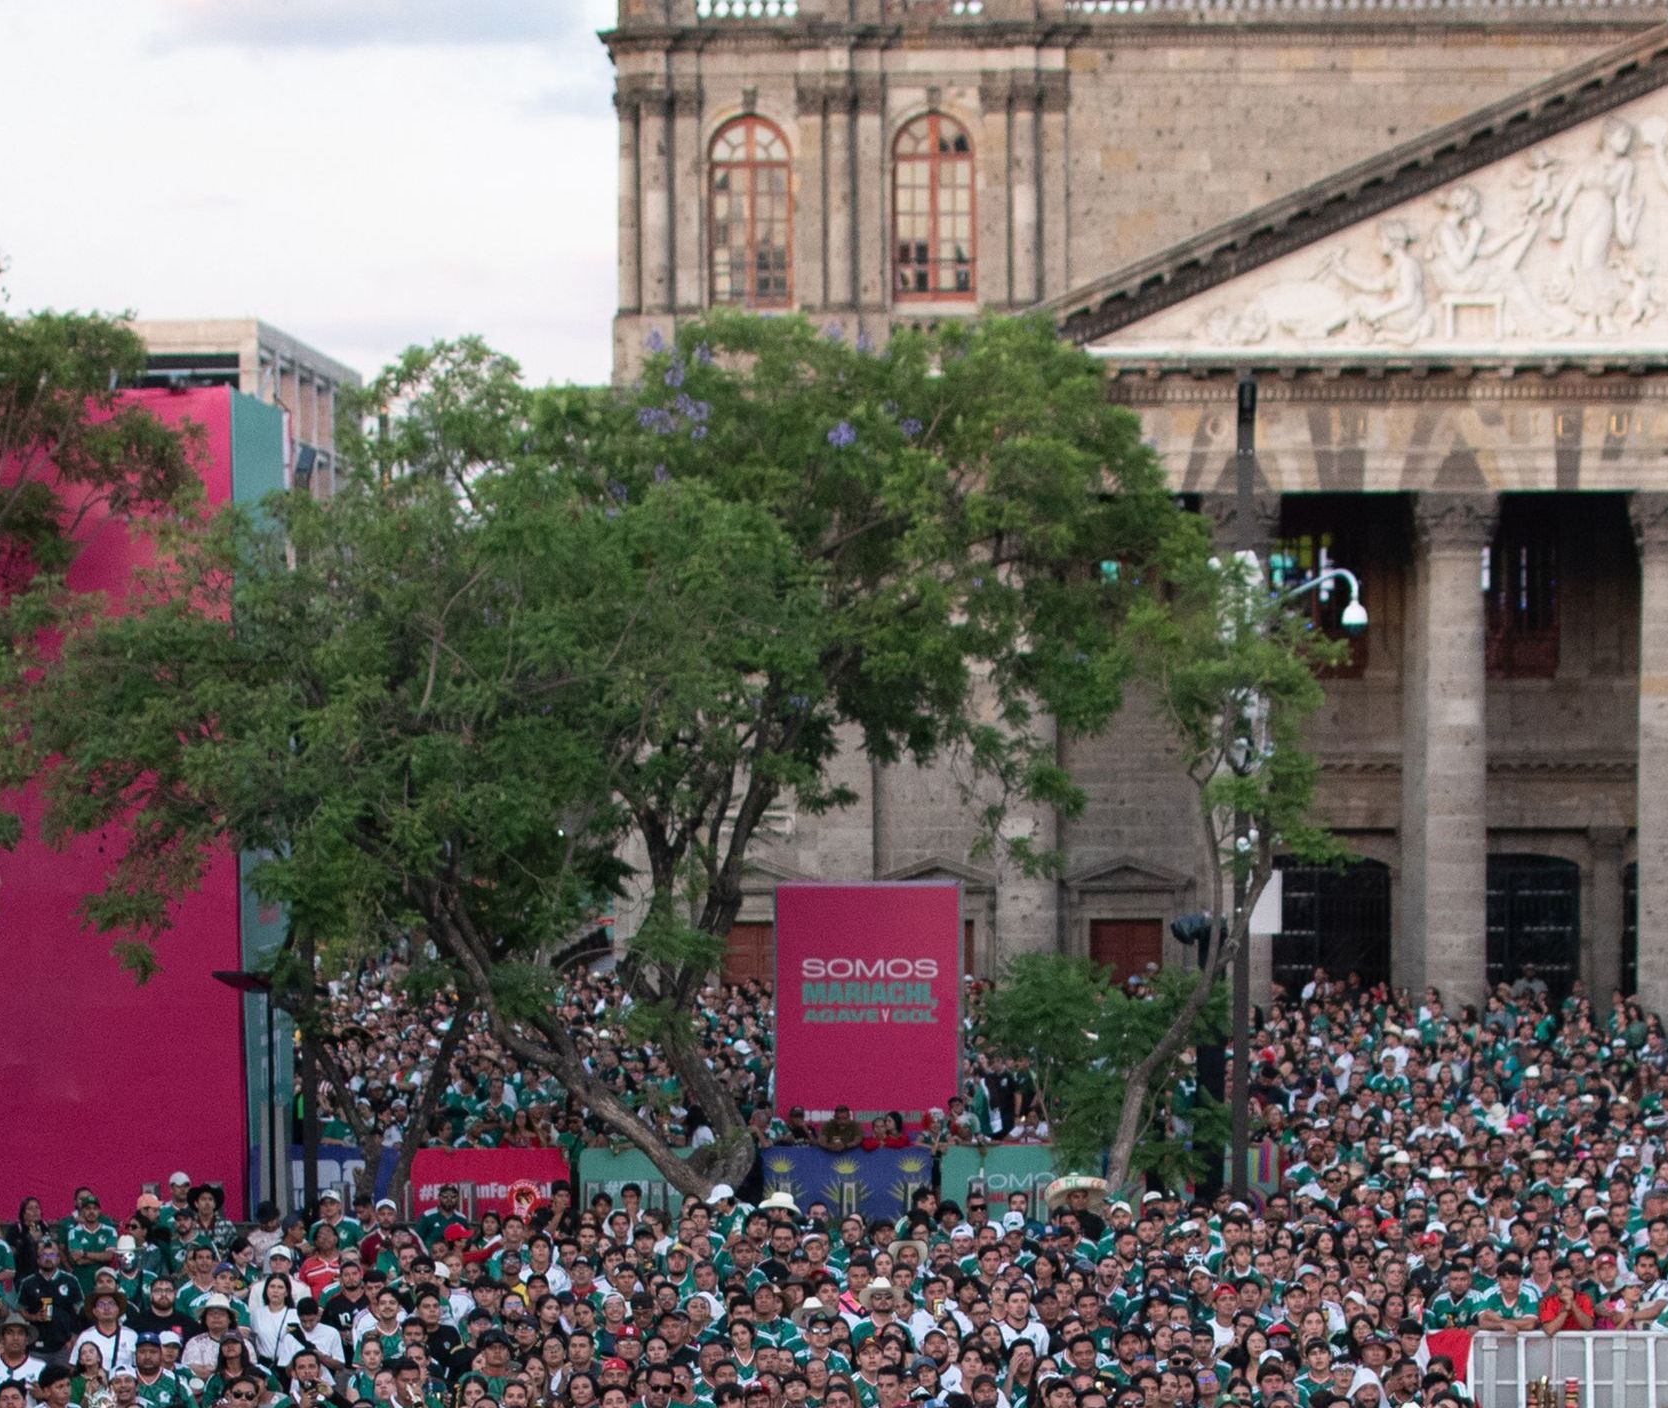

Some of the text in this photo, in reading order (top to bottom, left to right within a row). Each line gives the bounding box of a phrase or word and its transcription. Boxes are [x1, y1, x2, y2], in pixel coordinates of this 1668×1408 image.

[802, 958, 938, 979] SOMOS
[802, 981, 939, 1008] MARIACHI,
[803, 1008, 879, 1023] AGAVE
[892, 1008, 938, 1023] GOL
